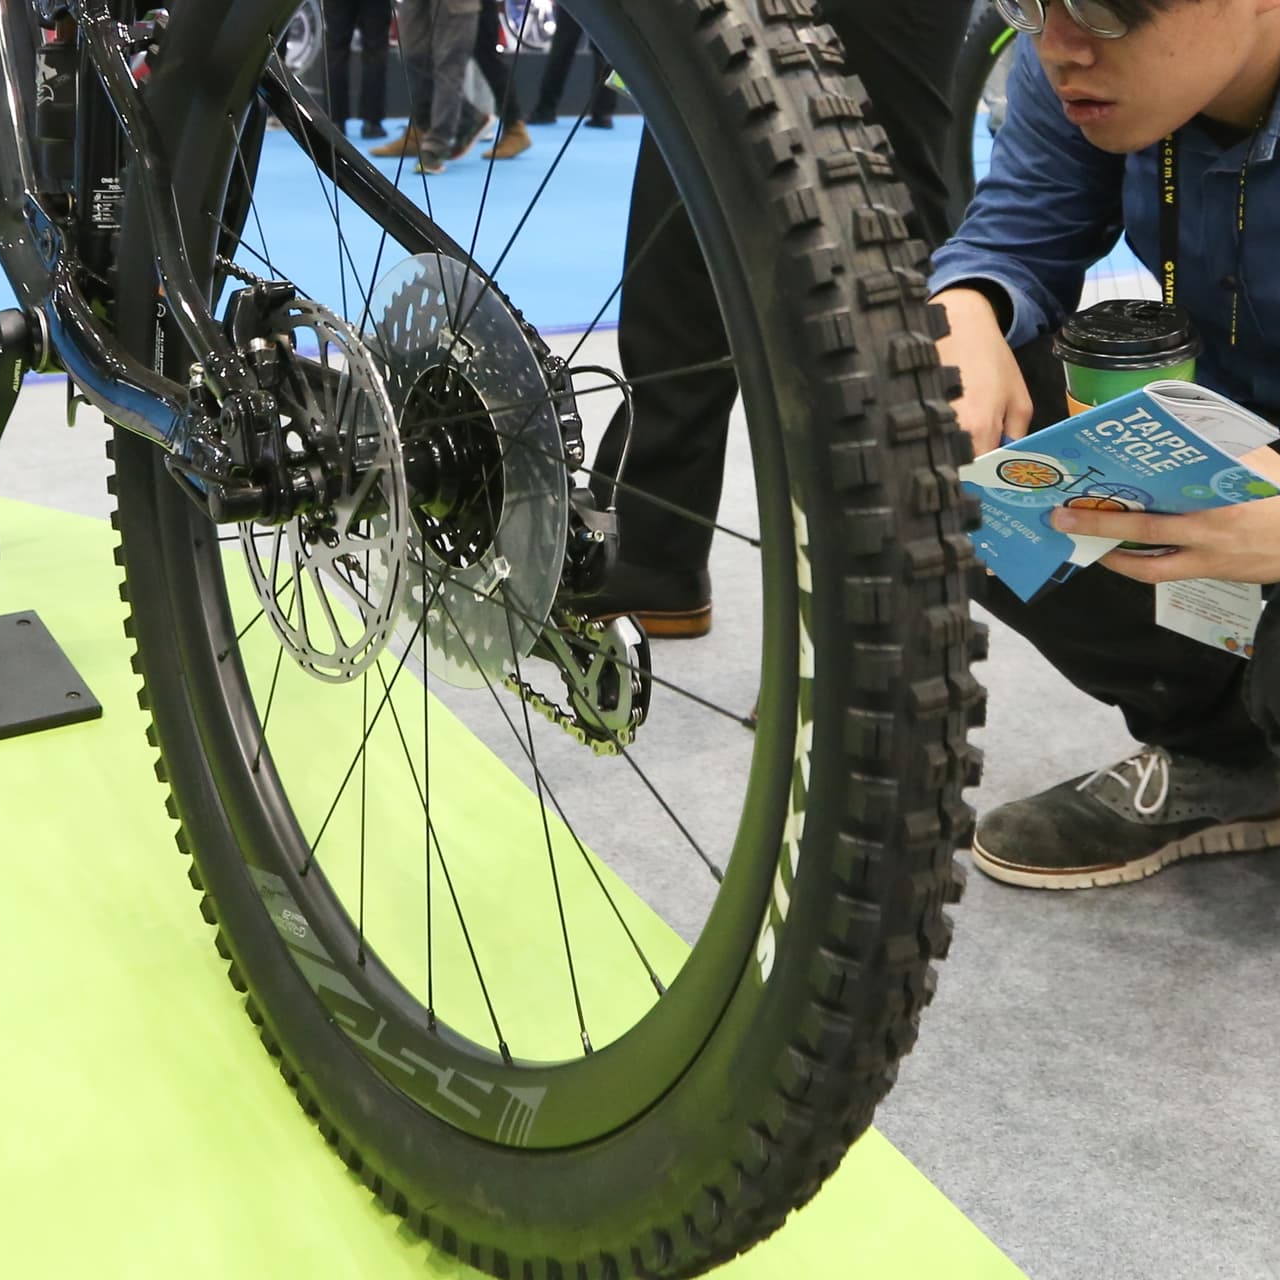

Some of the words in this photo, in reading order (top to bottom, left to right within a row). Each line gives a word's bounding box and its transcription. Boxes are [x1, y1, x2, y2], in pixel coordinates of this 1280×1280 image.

[1095, 419, 1182, 473] CYCLE
[1122, 406, 1209, 466] TAIPEI
[1010, 520, 1042, 545] GUIDE
